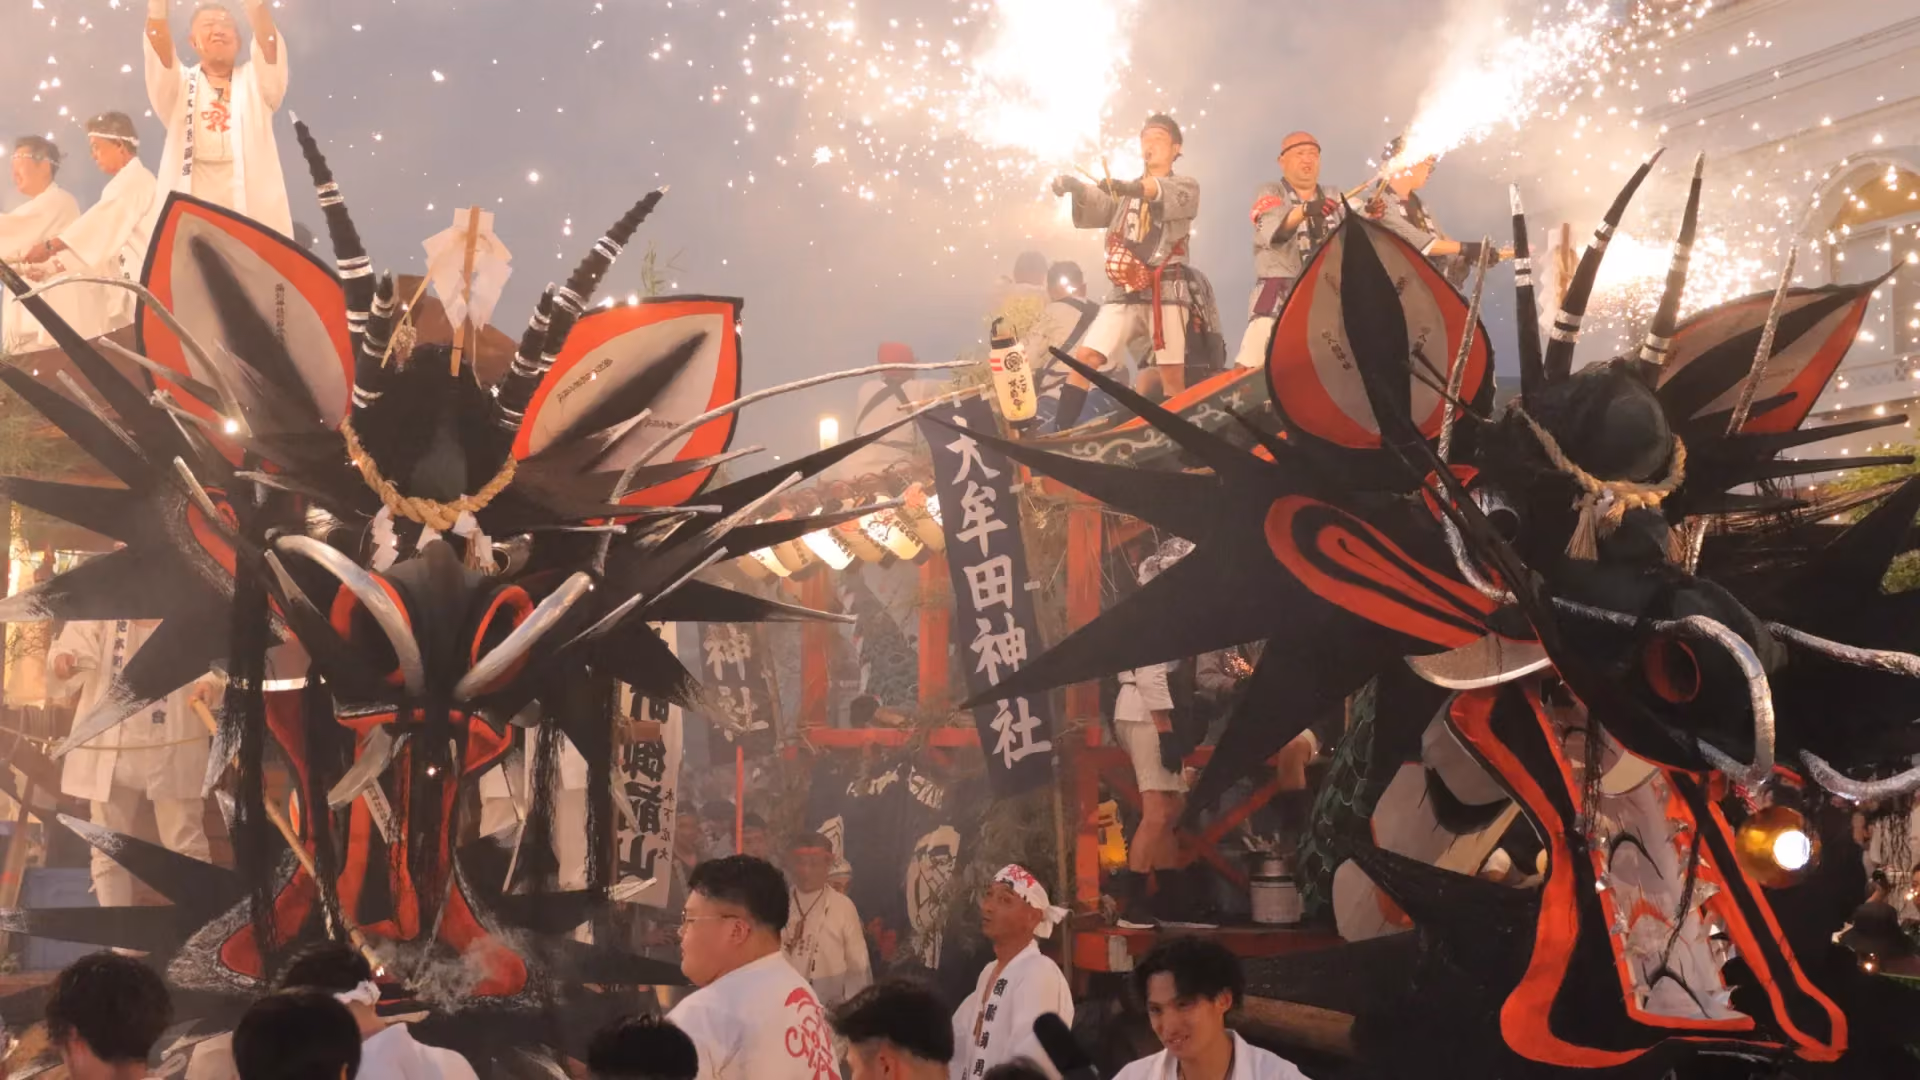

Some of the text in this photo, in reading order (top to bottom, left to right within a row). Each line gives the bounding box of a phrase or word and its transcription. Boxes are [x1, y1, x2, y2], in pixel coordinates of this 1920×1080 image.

[945, 415, 1053, 769] 大牟田神社
